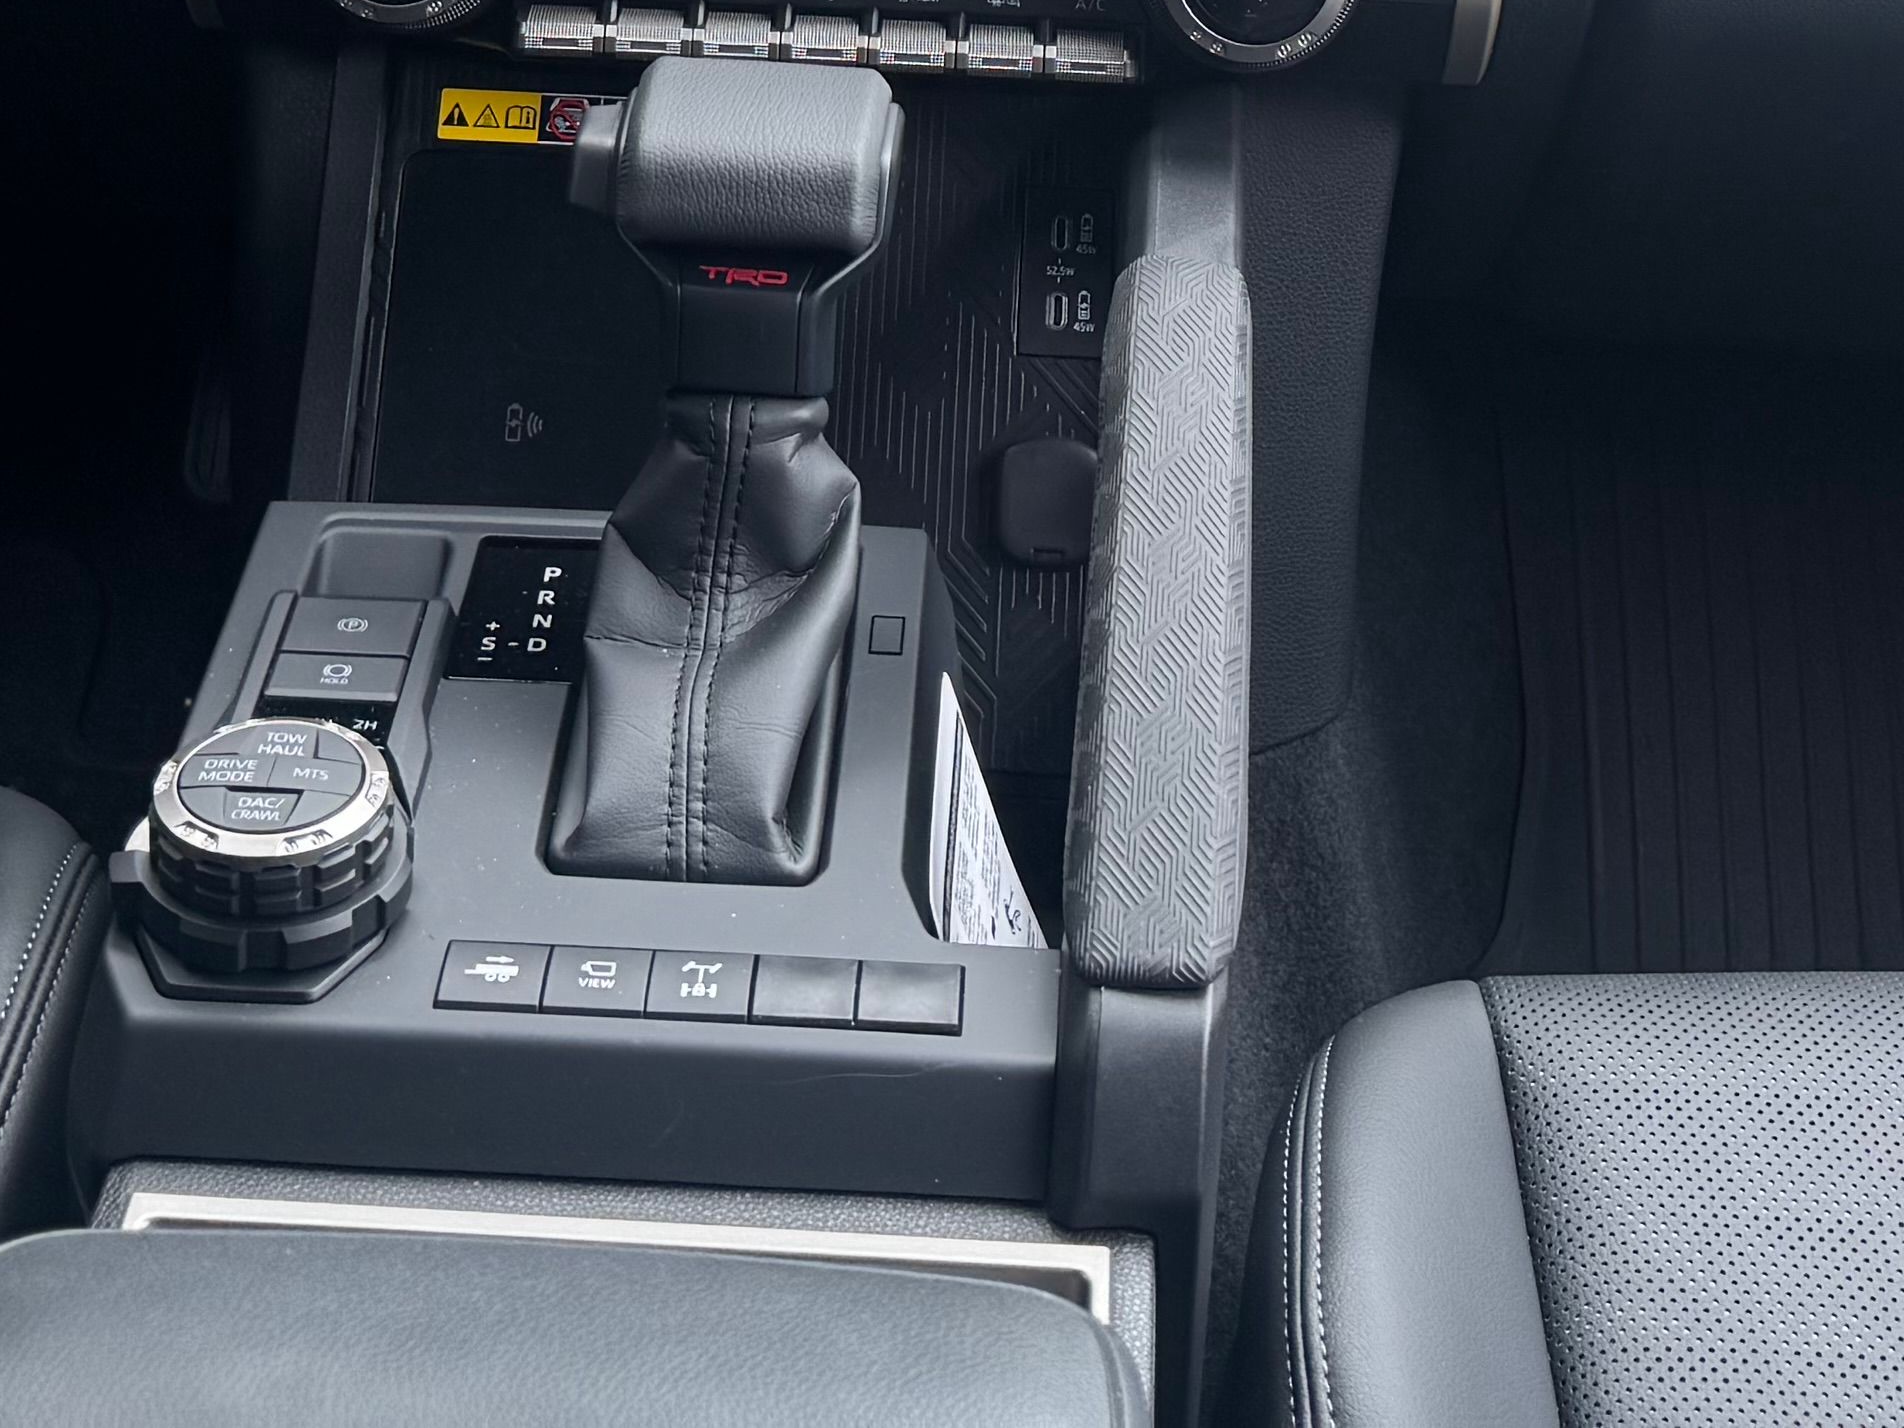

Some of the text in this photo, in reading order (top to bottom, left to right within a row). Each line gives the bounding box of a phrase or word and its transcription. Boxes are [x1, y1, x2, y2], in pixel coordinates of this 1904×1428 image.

[699, 265, 788, 286] TRD
[1073, 322, 1095, 332] 45W
[543, 567, 562, 582] P
[537, 590, 555, 604] R
[532, 614, 552, 628] N
[481, 637, 547, 651] S D
[352, 719, 378, 731] 2H
[266, 732, 307, 743] TOW
[258, 744, 305, 757] HAUL
[204, 758, 258, 769] DRIVE
[198, 770, 254, 782] MODE
[293, 767, 329, 780] MTS
[238, 797, 285, 809] DAC/
[231, 810, 280, 821] CRAWL
[578, 976, 616, 989] VIEW
